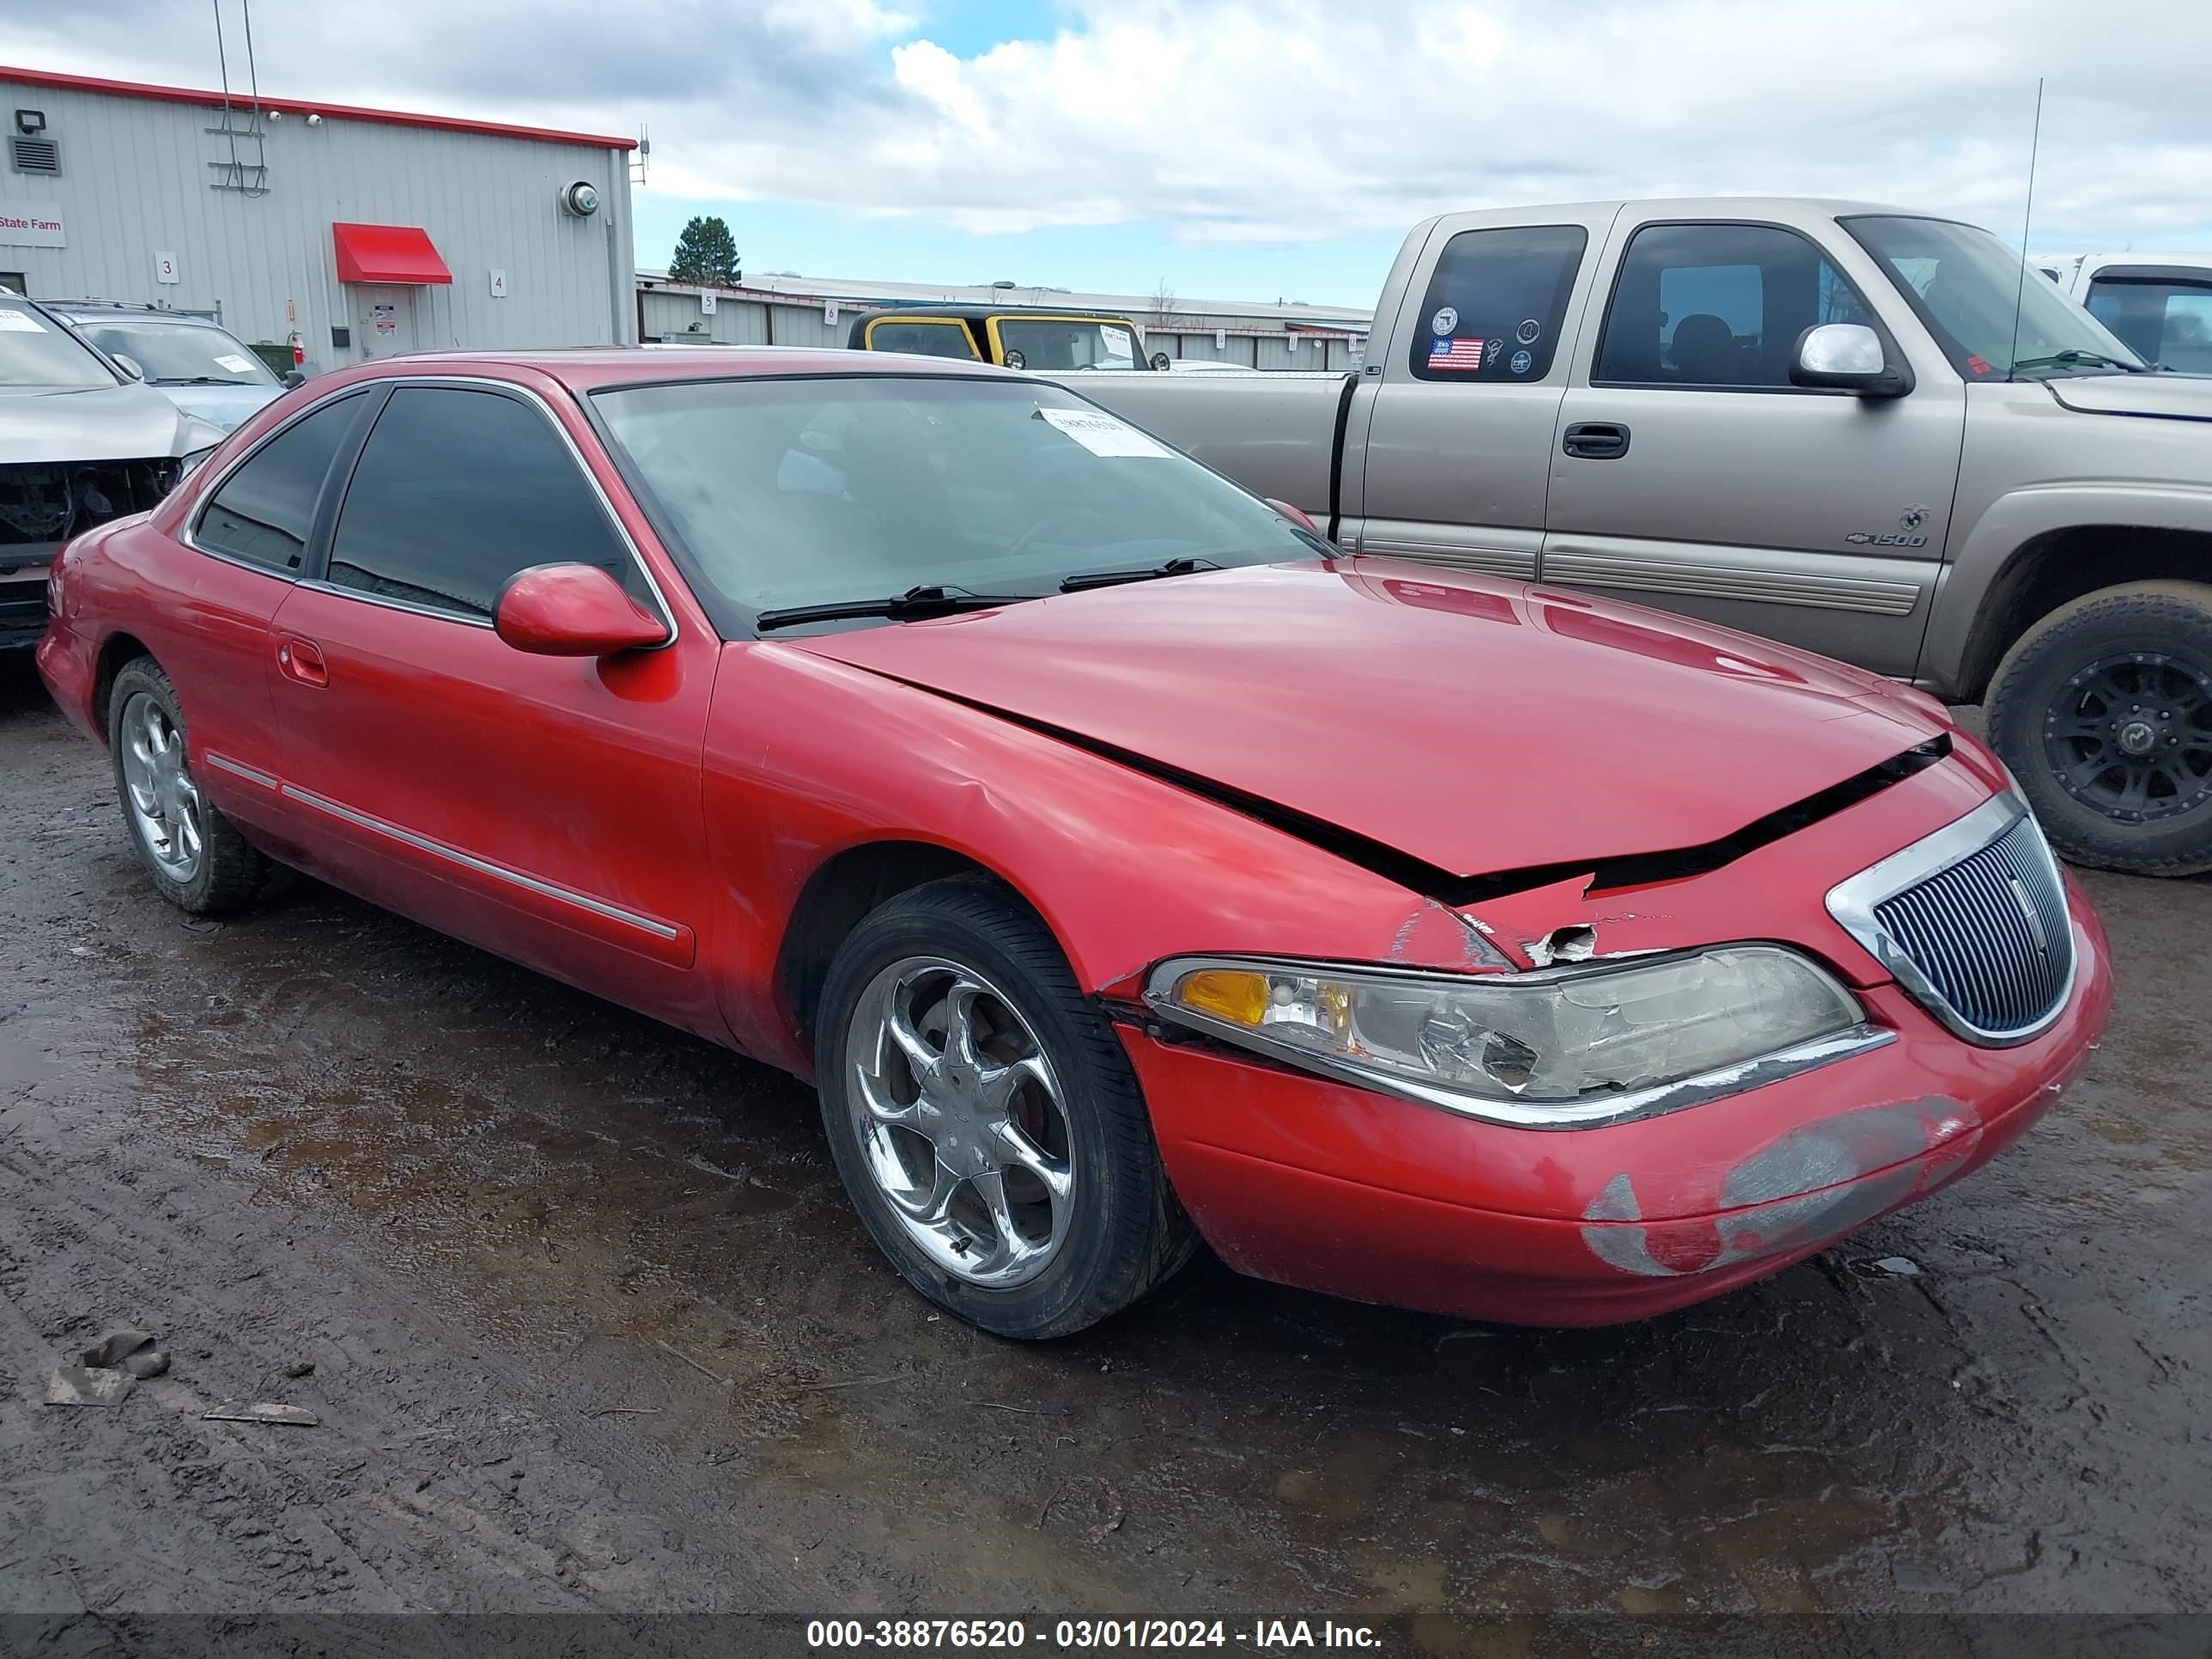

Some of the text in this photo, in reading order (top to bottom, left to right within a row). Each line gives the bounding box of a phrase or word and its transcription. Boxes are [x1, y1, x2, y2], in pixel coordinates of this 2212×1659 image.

[0, 217, 61, 230] State Farm
[163, 260, 172, 275] 3
[495, 276, 501, 289] 4
[707, 295, 712, 307] 5
[829, 308, 834, 318] 6
[1218, 333, 1224, 343] 10
[1350, 337, 1356, 346] 12
[1366, 366, 1381, 375] LS
[1867, 532, 1927, 547] 1500
